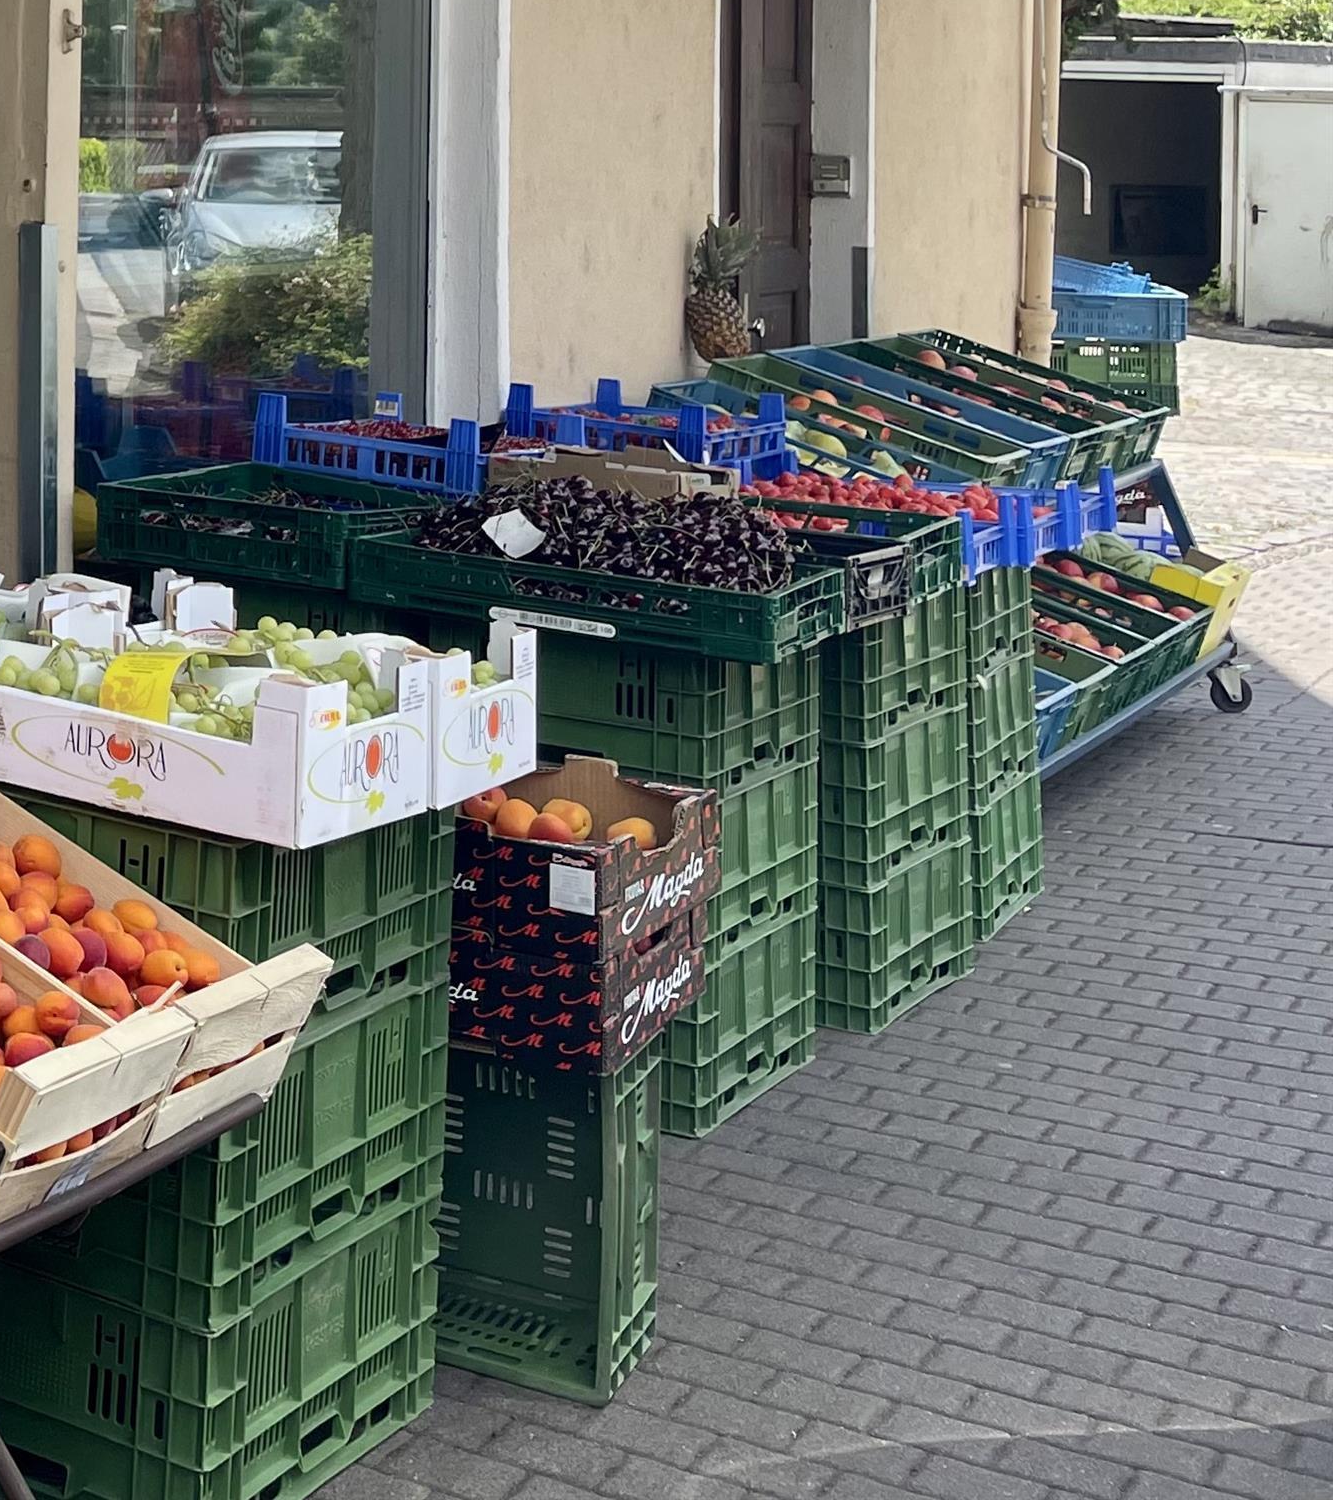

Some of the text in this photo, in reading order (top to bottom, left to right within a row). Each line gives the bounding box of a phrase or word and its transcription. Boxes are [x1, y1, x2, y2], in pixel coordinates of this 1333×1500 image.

[64, 720, 167, 782] AURORA
[467, 697, 515, 755] AURORA
[340, 728, 400, 792] AURORA
[621, 851, 705, 936] Magda
[621, 954, 692, 1045] Magda
